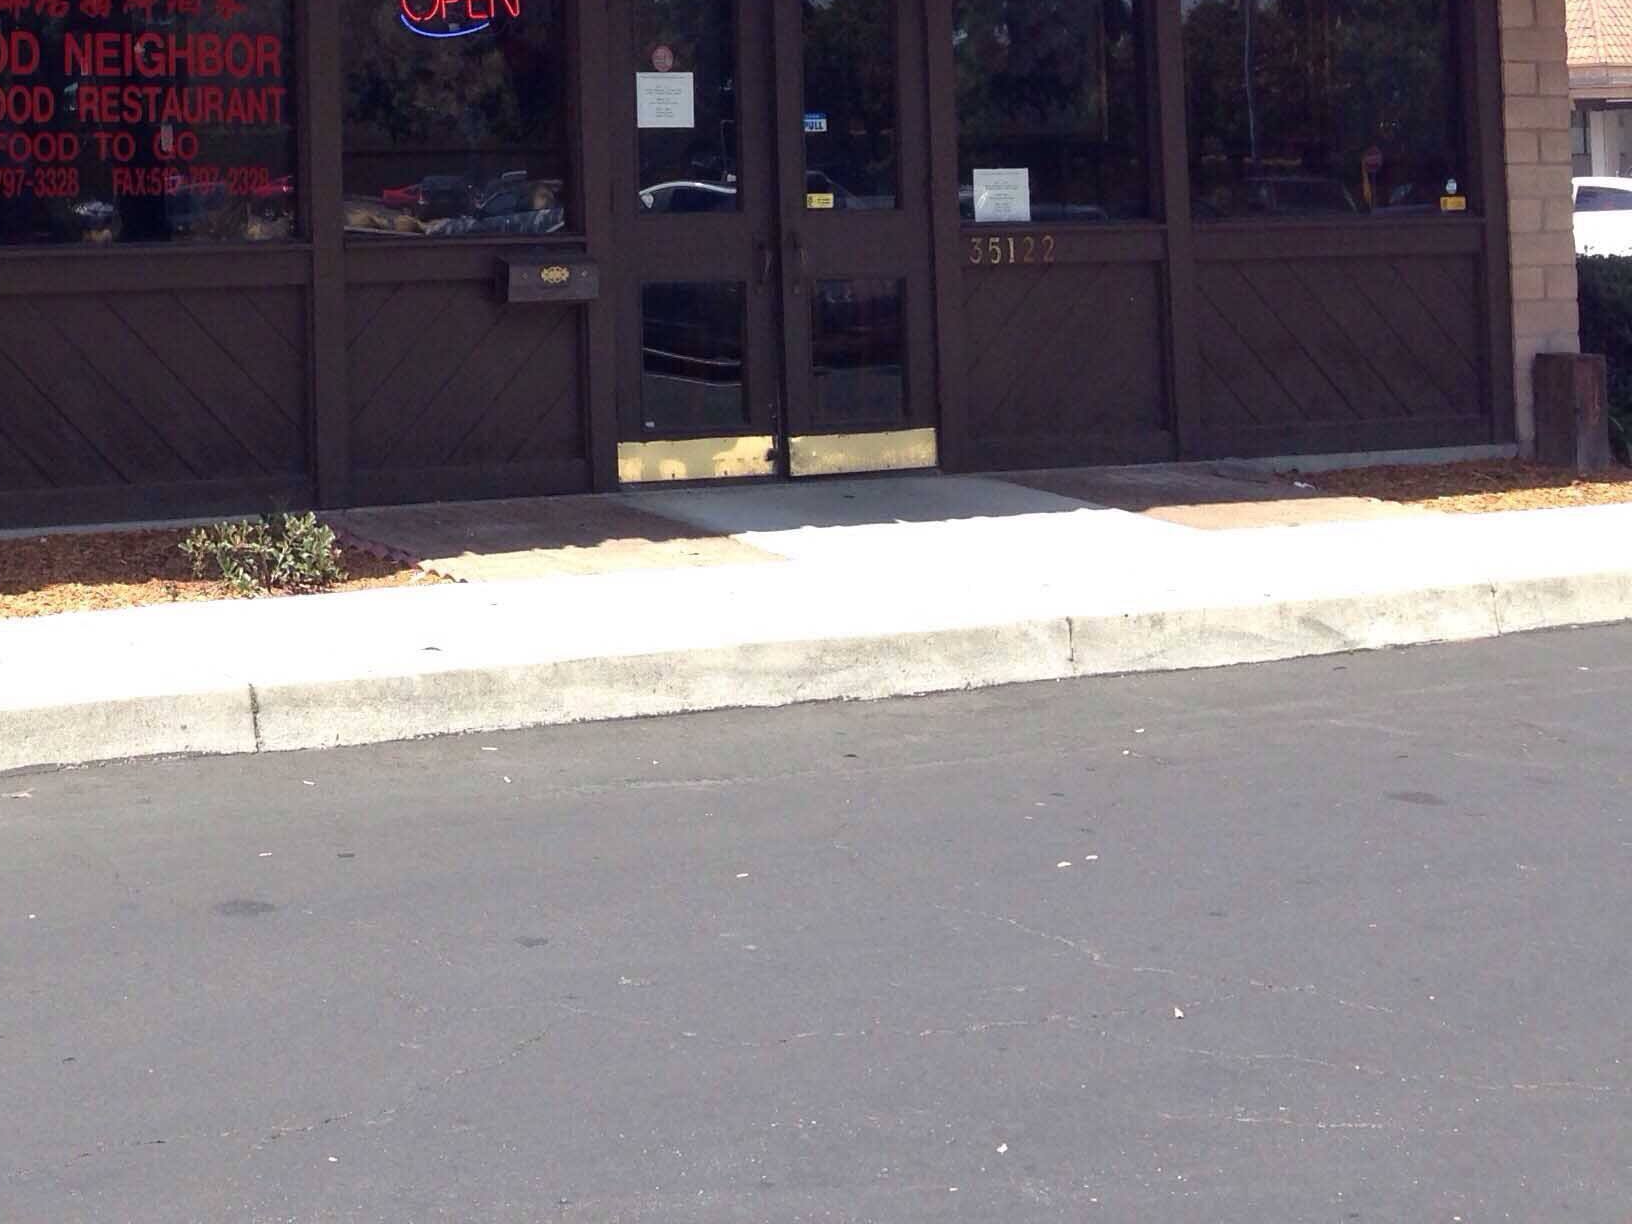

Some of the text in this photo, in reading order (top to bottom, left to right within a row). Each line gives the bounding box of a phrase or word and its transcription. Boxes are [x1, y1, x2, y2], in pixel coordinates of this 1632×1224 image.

[64, 31, 282, 78] NEIGHBOR
[77, 84, 287, 124] RESTAURANT
[96, 130, 136, 163] TO
[152, 129, 200, 163] GO
[968, 235, 1055, 265] 35122
